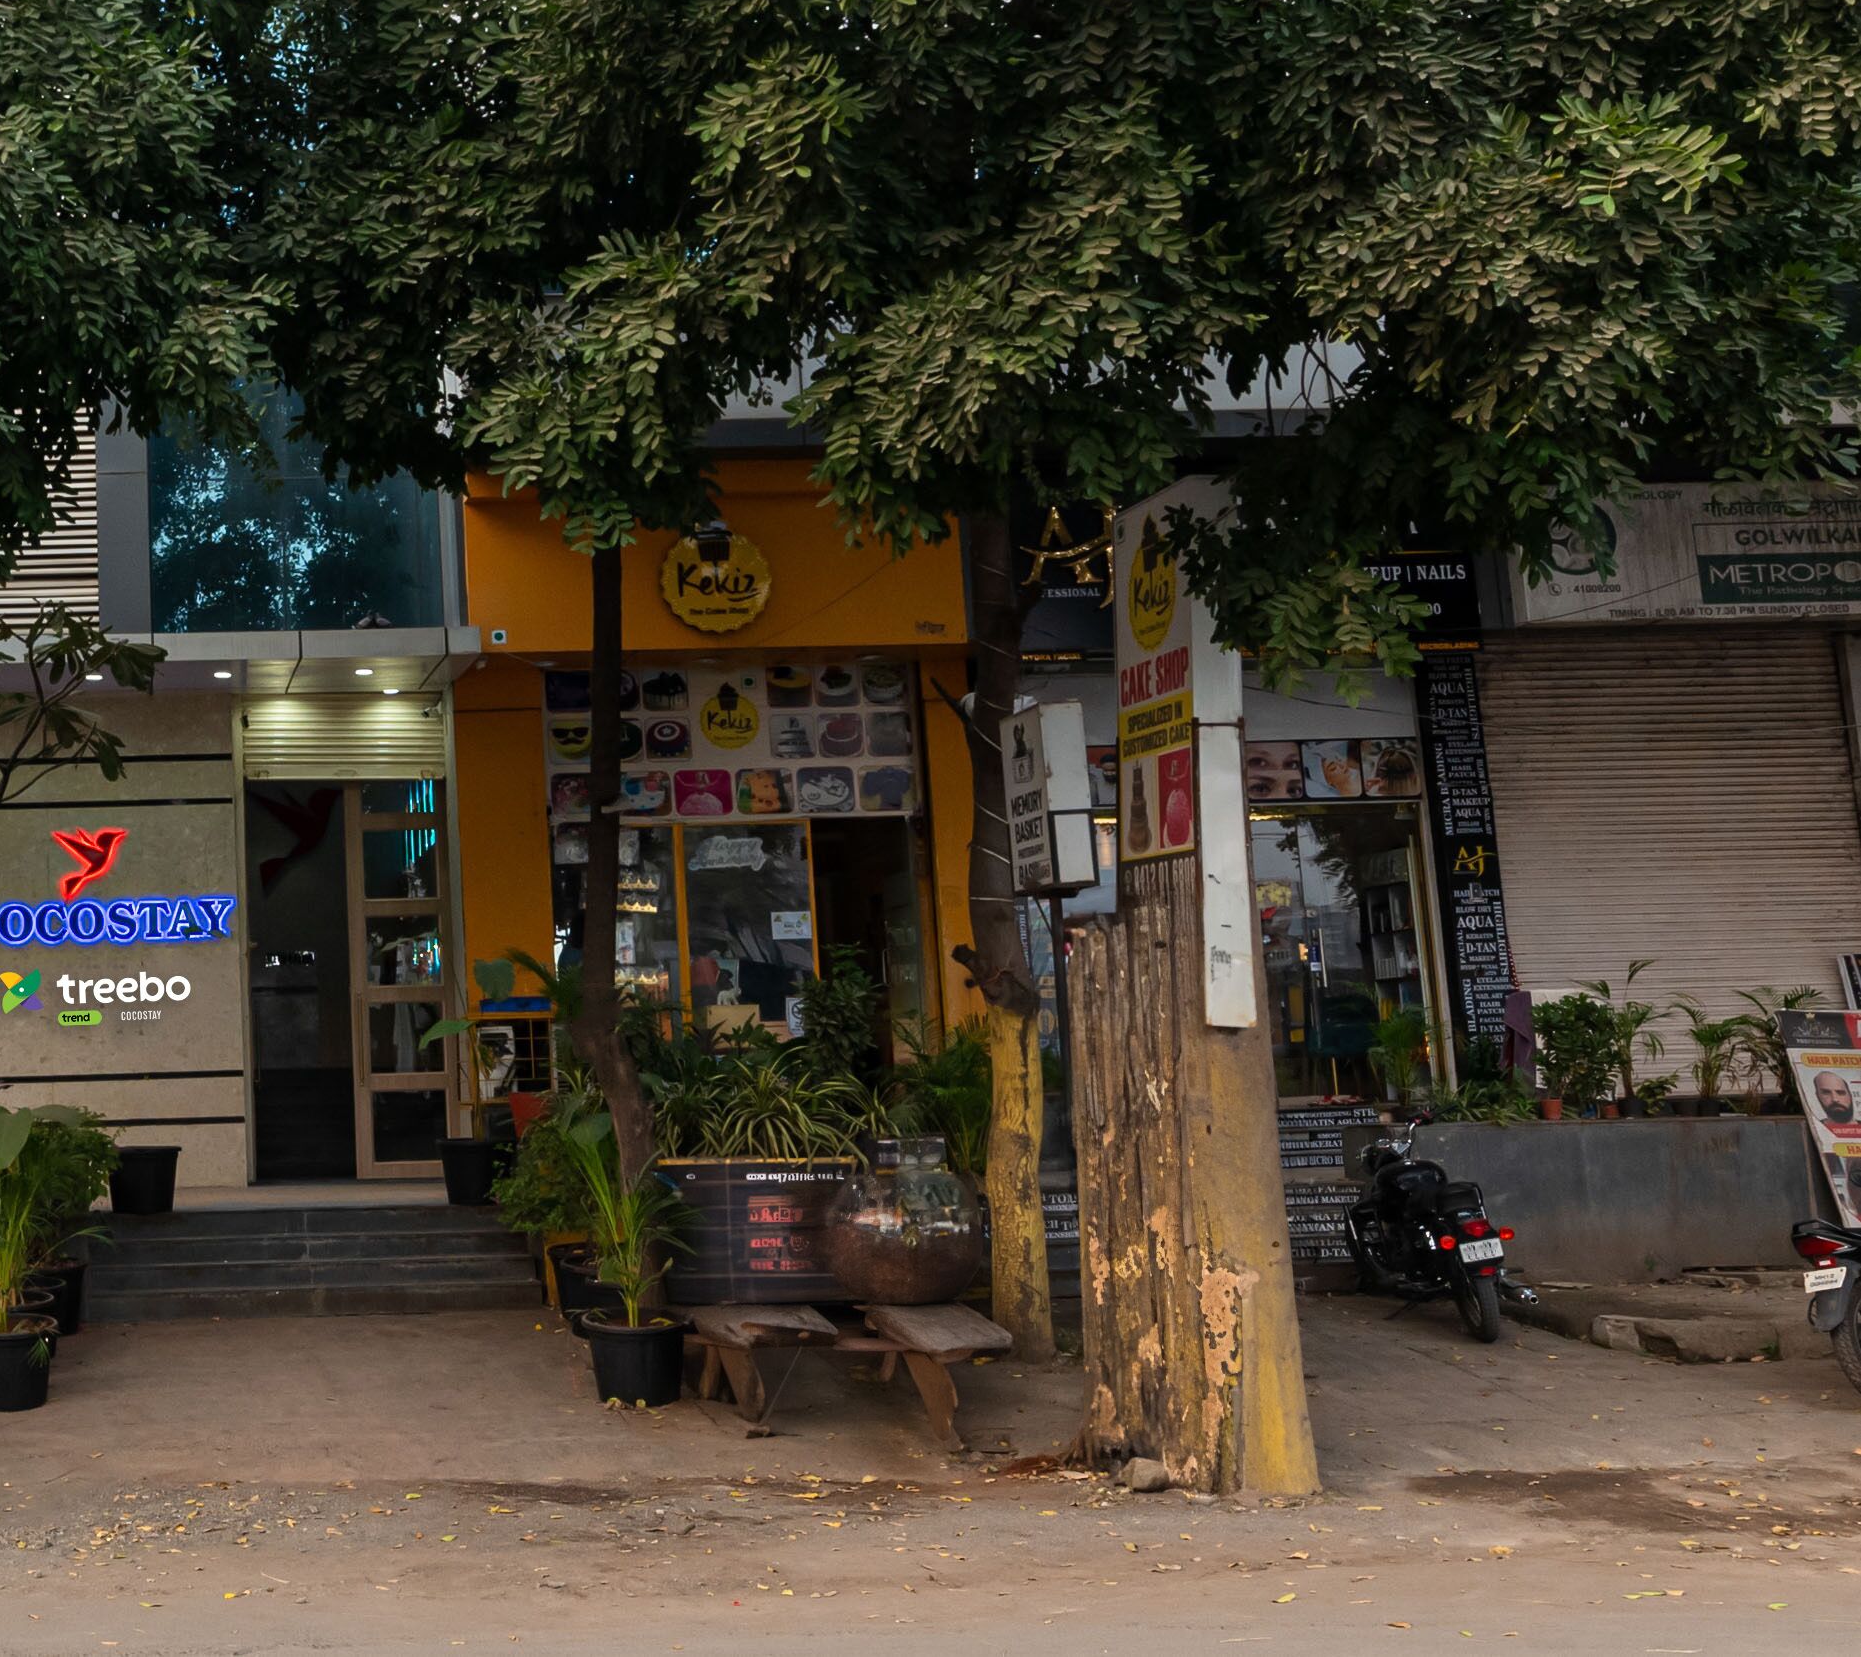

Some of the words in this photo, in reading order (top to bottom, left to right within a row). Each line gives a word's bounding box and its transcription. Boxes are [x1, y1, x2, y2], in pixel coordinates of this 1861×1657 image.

[1416, 563, 1467, 580] NAILS
[676, 562, 761, 602] Kekiz
[1120, 659, 1152, 708] CAKE
[1155, 645, 1190, 696] SHOP
[1457, 915, 1495, 930] AQUA
[1466, 942, 1497, 953] D-TAN
[56, 971, 192, 1005] treebo
[61, 1012, 91, 1024] trend
[121, 1009, 162, 1021] COCOSTAY
